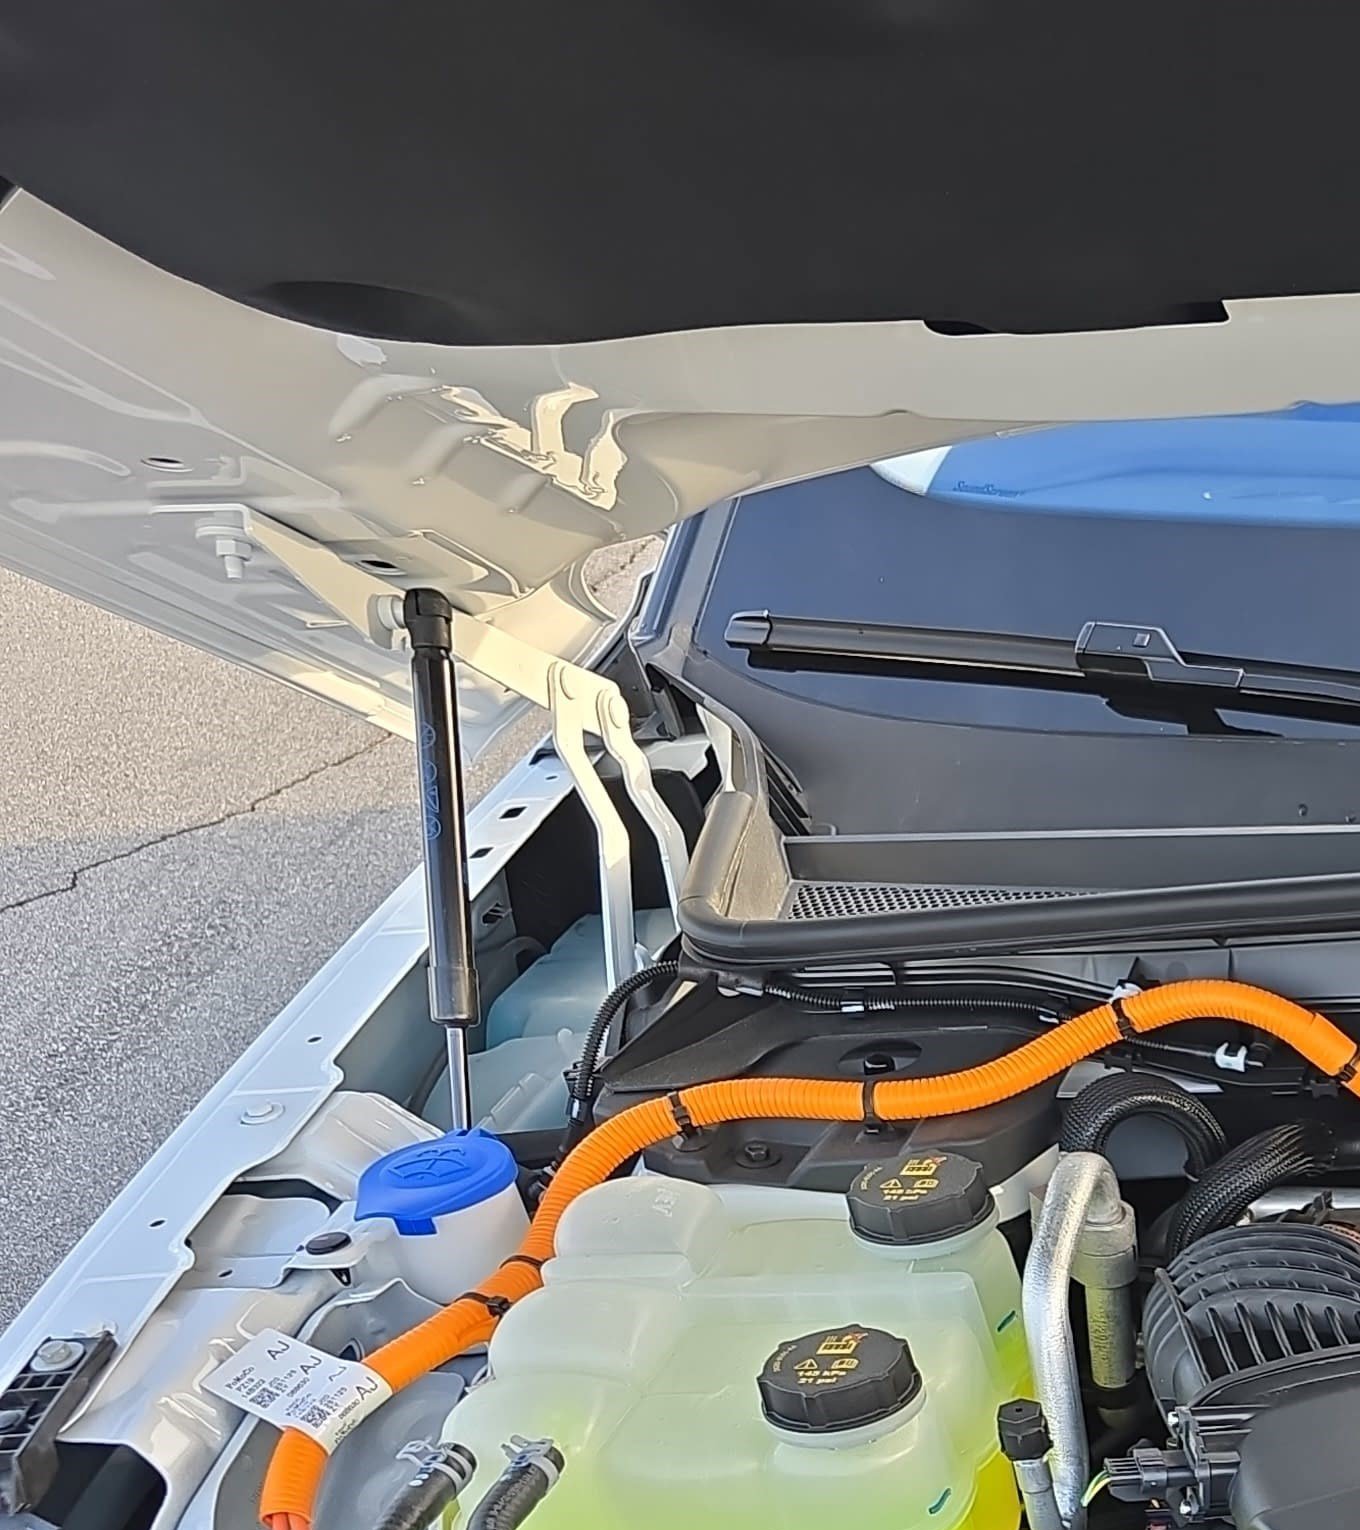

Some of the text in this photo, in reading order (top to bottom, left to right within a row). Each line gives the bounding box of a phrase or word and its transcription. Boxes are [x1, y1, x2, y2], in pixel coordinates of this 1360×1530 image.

[266, 1340, 290, 1361] AJ
[300, 1355, 322, 1376] AJ
[355, 1376, 379, 1401] AJ
